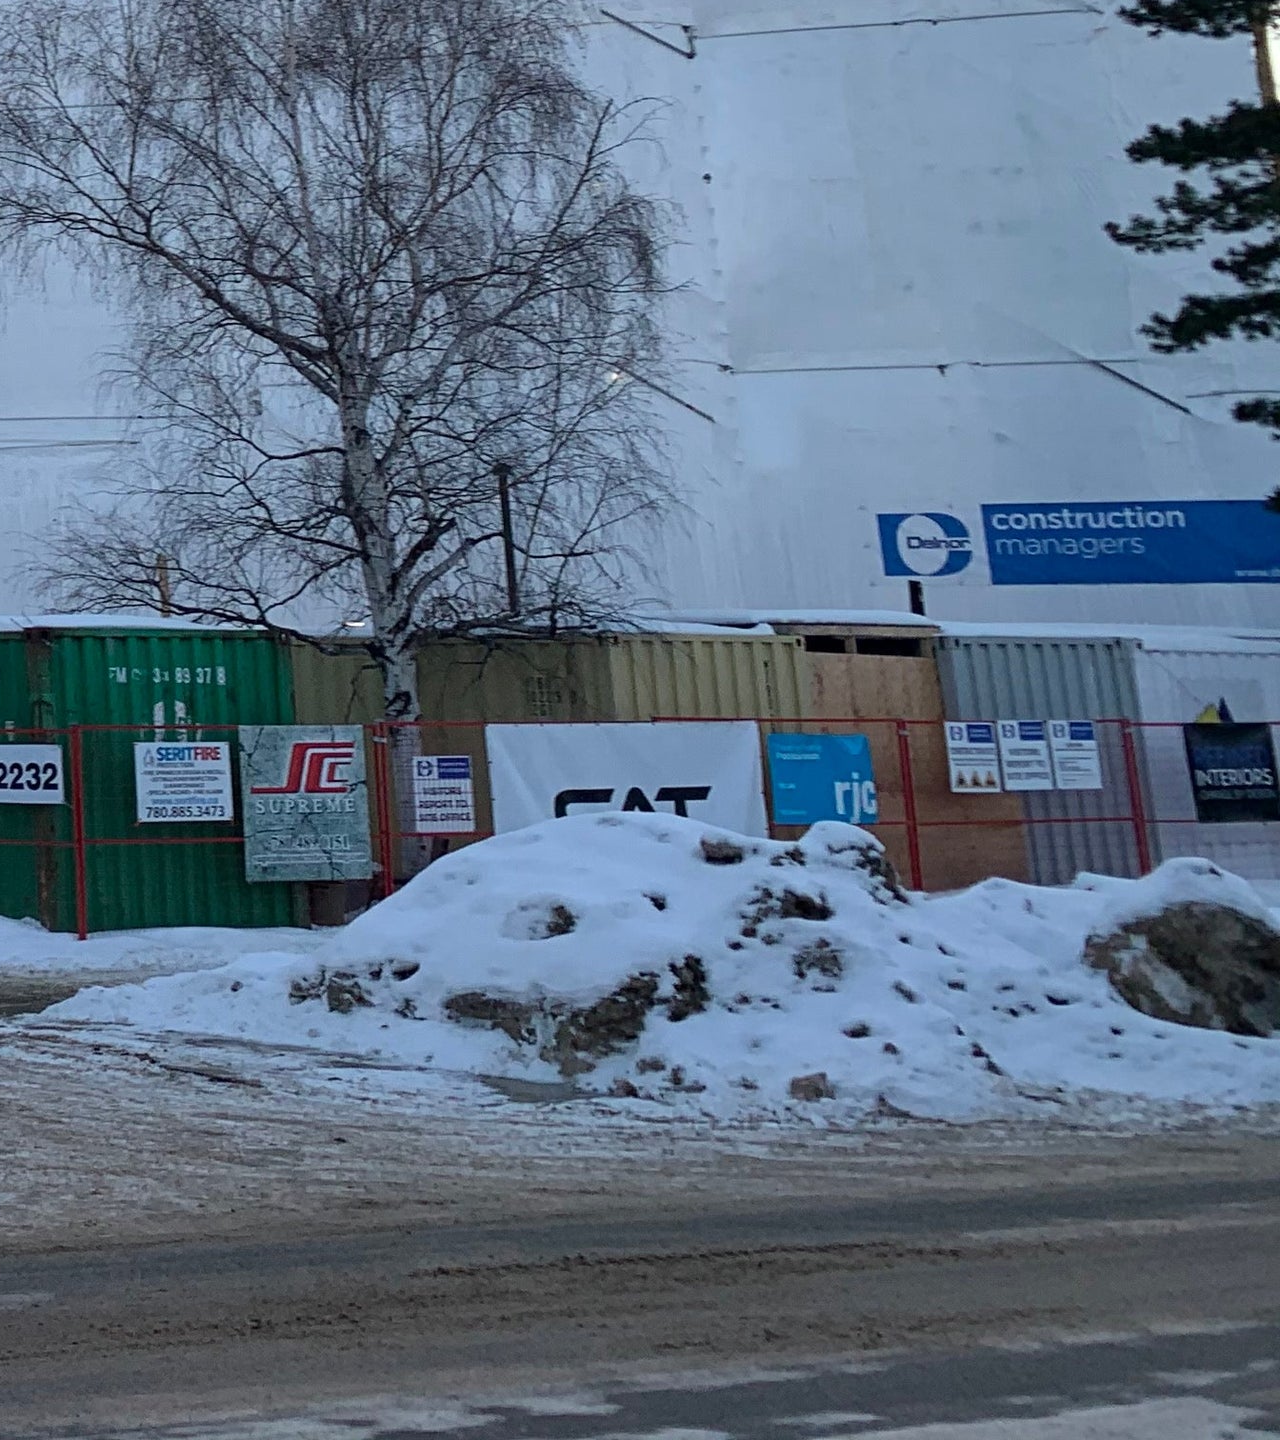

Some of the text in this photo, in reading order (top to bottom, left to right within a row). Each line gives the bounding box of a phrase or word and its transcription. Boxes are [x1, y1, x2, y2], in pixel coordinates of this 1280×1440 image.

[990, 506, 1188, 532] construction
[906, 535, 971, 550] Delnor
[994, 534, 1147, 558] managers
[1194, 767, 1274, 787] INTERIORS
[254, 798, 356, 815] SUPREME
[833, 771, 878, 825] rjc
[145, 806, 226, 818] 780.885.3473
